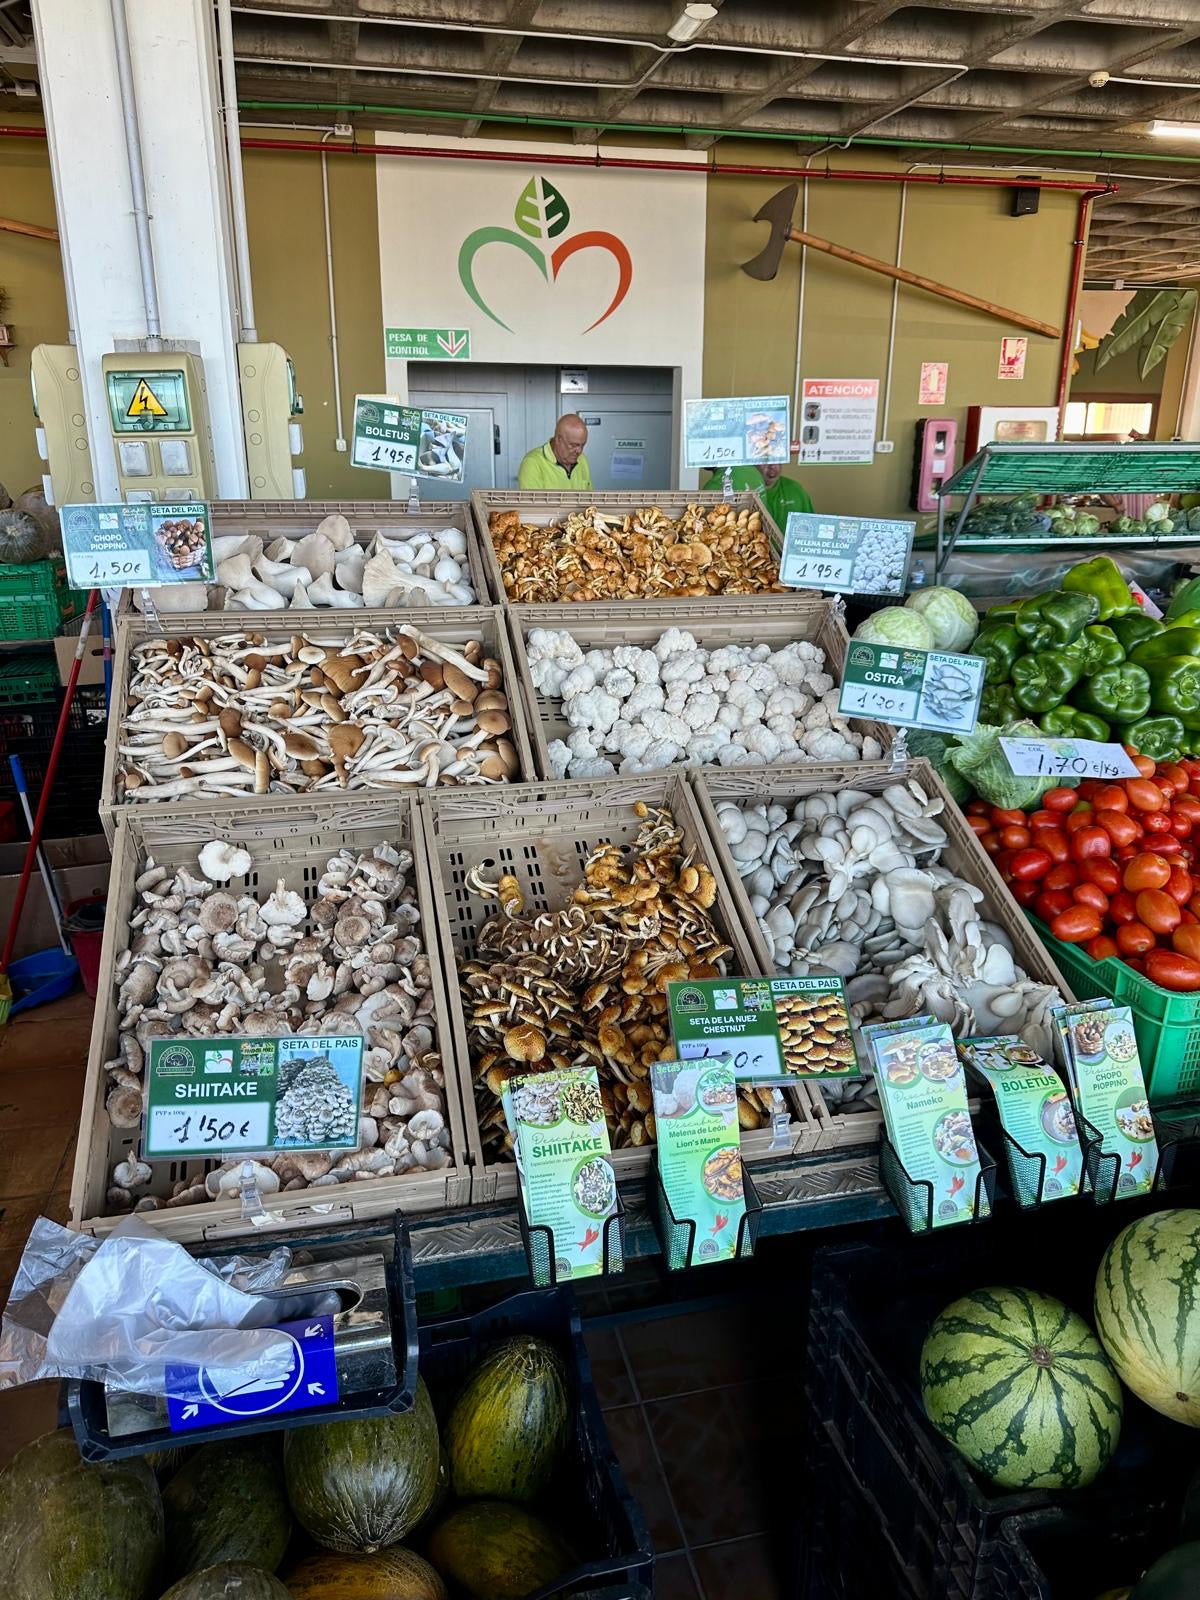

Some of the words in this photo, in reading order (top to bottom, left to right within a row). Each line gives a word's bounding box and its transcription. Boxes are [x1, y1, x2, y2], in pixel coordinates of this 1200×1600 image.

[389, 333, 412, 342] PESA
[416, 333, 428, 342] DE
[388, 346, 430, 355] CONTROL
[808, 384, 873, 395] ATENCIÓN
[424, 411, 439, 420] SETA
[440, 414, 450, 422] DEL
[365, 426, 410, 441] BOLETUS
[862, 522, 879, 530] SETA
[93, 533, 122, 542] CHOPO
[90, 542, 127, 550] PIOPPINO
[822, 541, 831, 549] DE
[929, 654, 947, 663] SETA
[948, 657, 962, 665] DEL
[864, 671, 905, 686] OSTRA
[773, 980, 797, 990] SETA
[798, 980, 817, 989] DEL
[818, 978, 839, 988] PAÍS
[689, 1017, 711, 1026] SETA
[711, 1016, 723, 1025] DE
[723, 1016, 735, 1024] LA
[735, 1014, 758, 1023] NUEZ
[703, 1025, 746, 1034] CHESTNUT
[282, 1040, 310, 1050] SETA
[311, 1040, 332, 1049] DEL
[335, 1039, 359, 1049] PAIS
[656, 1063, 681, 1075] Setas
[1095, 1070, 1122, 1081] CHOPO
[1001, 1075, 1057, 1093] BOLETUS
[1093, 1078, 1129, 1091] PIOPPINO
[174, 1082, 258, 1099] SHIITAKE
[906, 1096, 944, 1110] Nameko
[669, 1128, 696, 1139] Melena
[697, 1127, 707, 1135] de
[707, 1124, 727, 1133] León
[532, 1137, 603, 1159] SHIITAKE
[676, 1139, 699, 1149] Lion's
[700, 1136, 720, 1145] Mane
